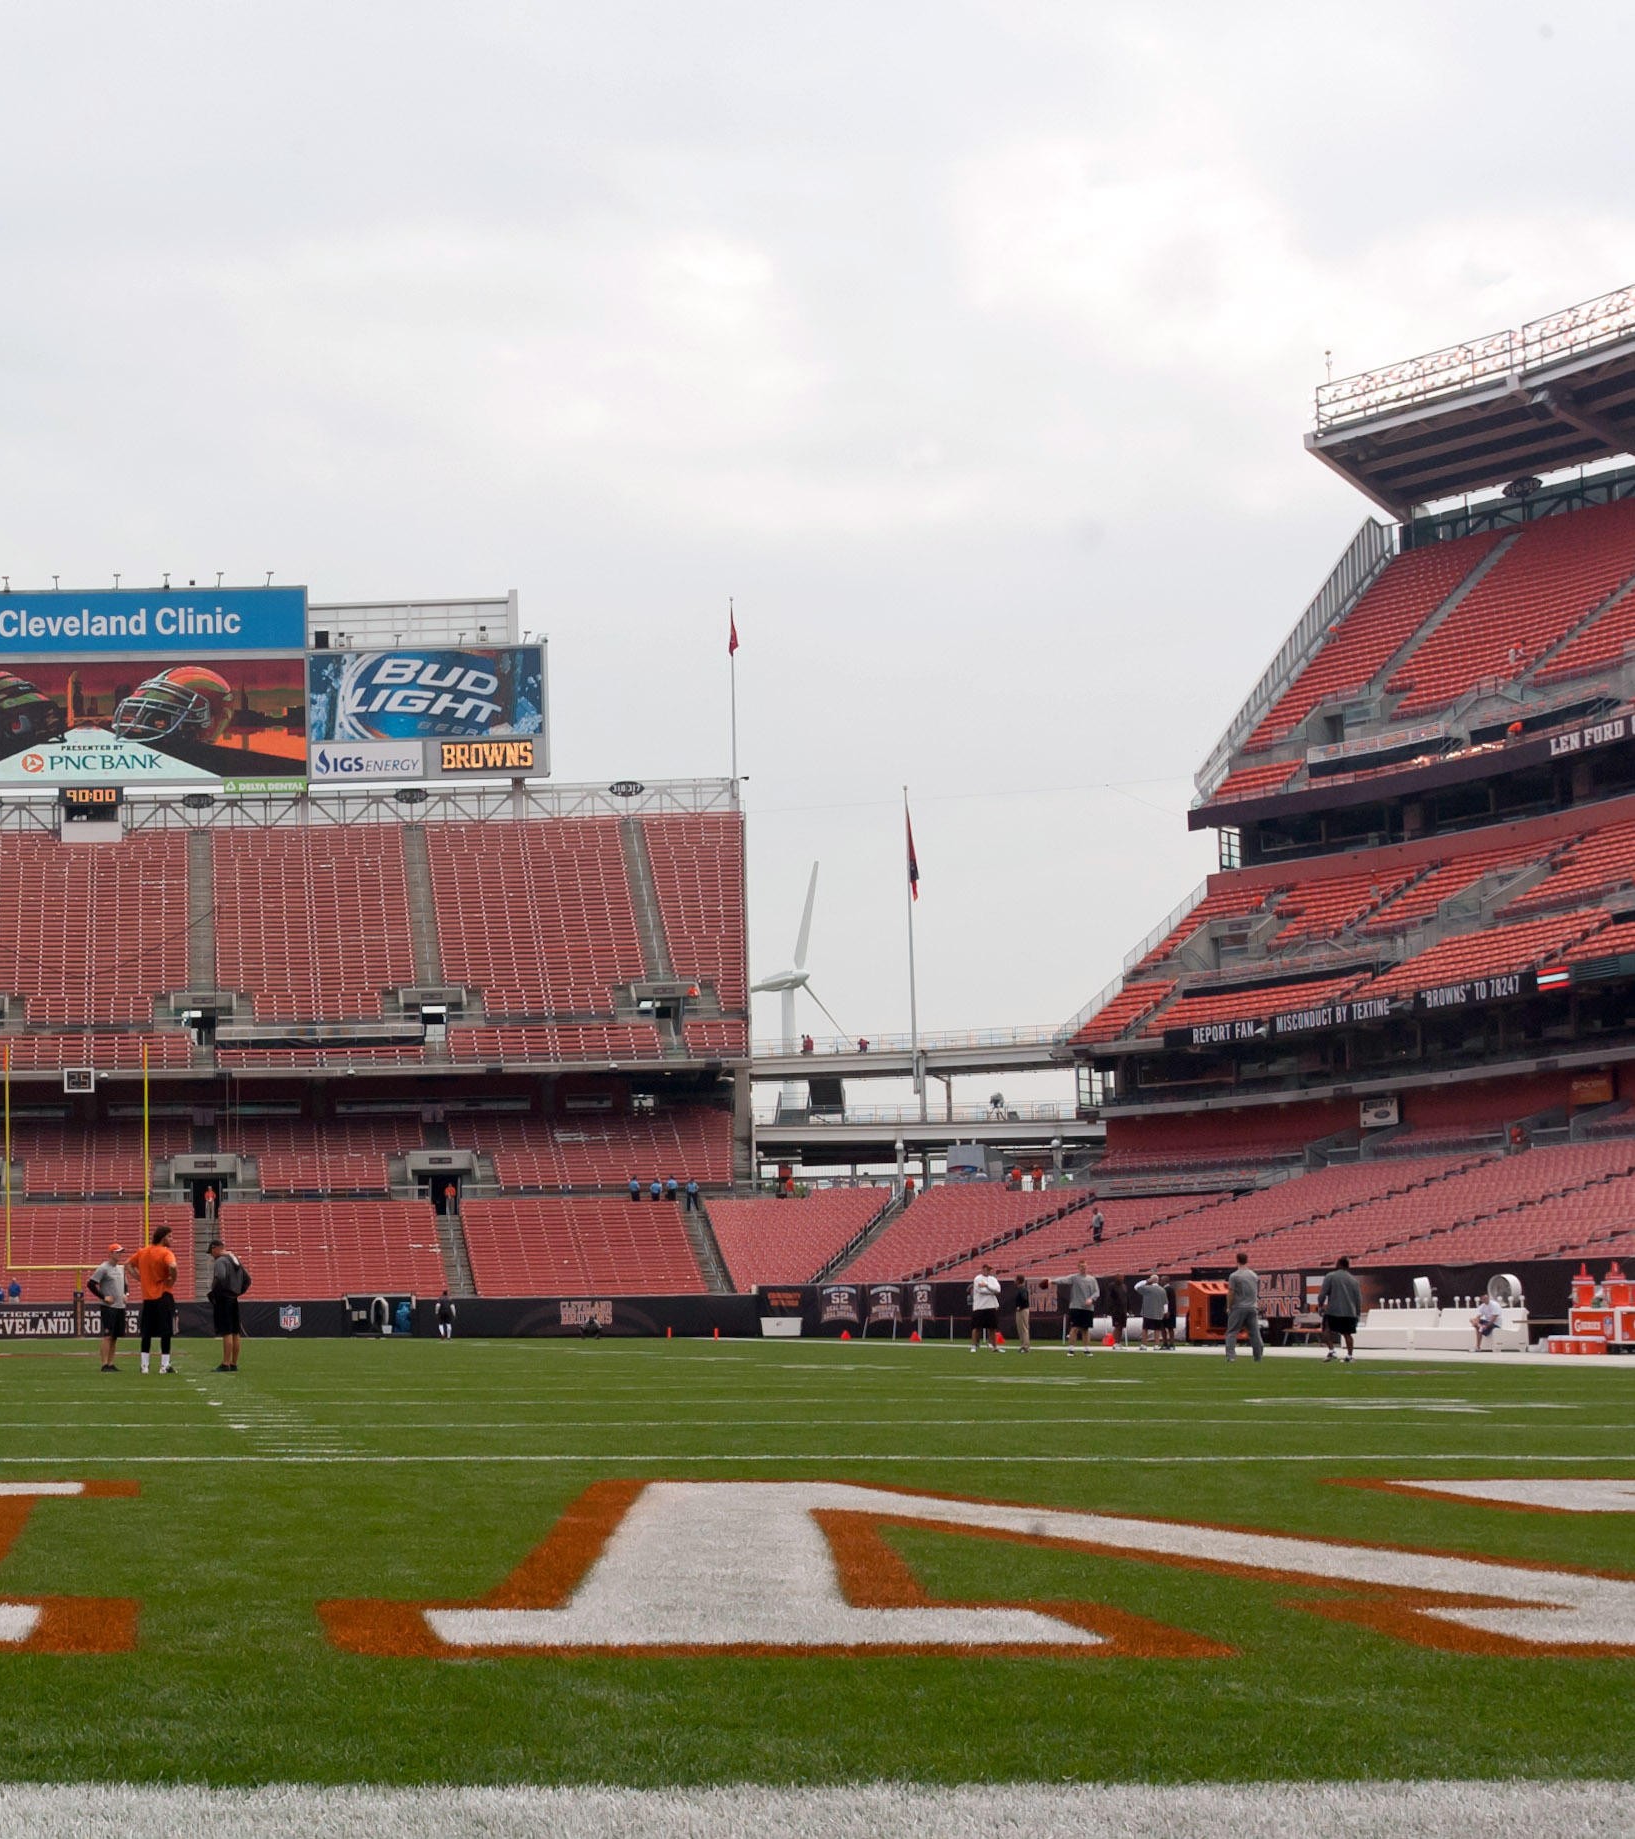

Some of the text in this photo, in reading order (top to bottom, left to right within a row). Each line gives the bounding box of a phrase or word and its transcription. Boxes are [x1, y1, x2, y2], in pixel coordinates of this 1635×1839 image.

[155, 606, 241, 635] Clinic
[372, 658, 498, 696] BUD
[346, 687, 502, 723] LIGHT
[1550, 732, 1581, 756] LEN
[1584, 720, 1625, 747] FORD
[333, 756, 419, 772] IGS ENERGY
[441, 742, 534, 770] BROWNS
[66, 789, 116, 803] 90:00
[239, 782, 304, 791] DELTA DENTAL
[1474, 982, 1486, 1001] TO
[1490, 976, 1520, 1000] 78247
[1276, 1007, 1332, 1033] MISCONDUCT
[1336, 1005, 1347, 1023] BY
[1193, 1020, 1254, 1044] REPORT FAN
[831, 1292, 849, 1304] 52
[879, 1292, 893, 1304] 31
[917, 1291, 928, 1303] 23
